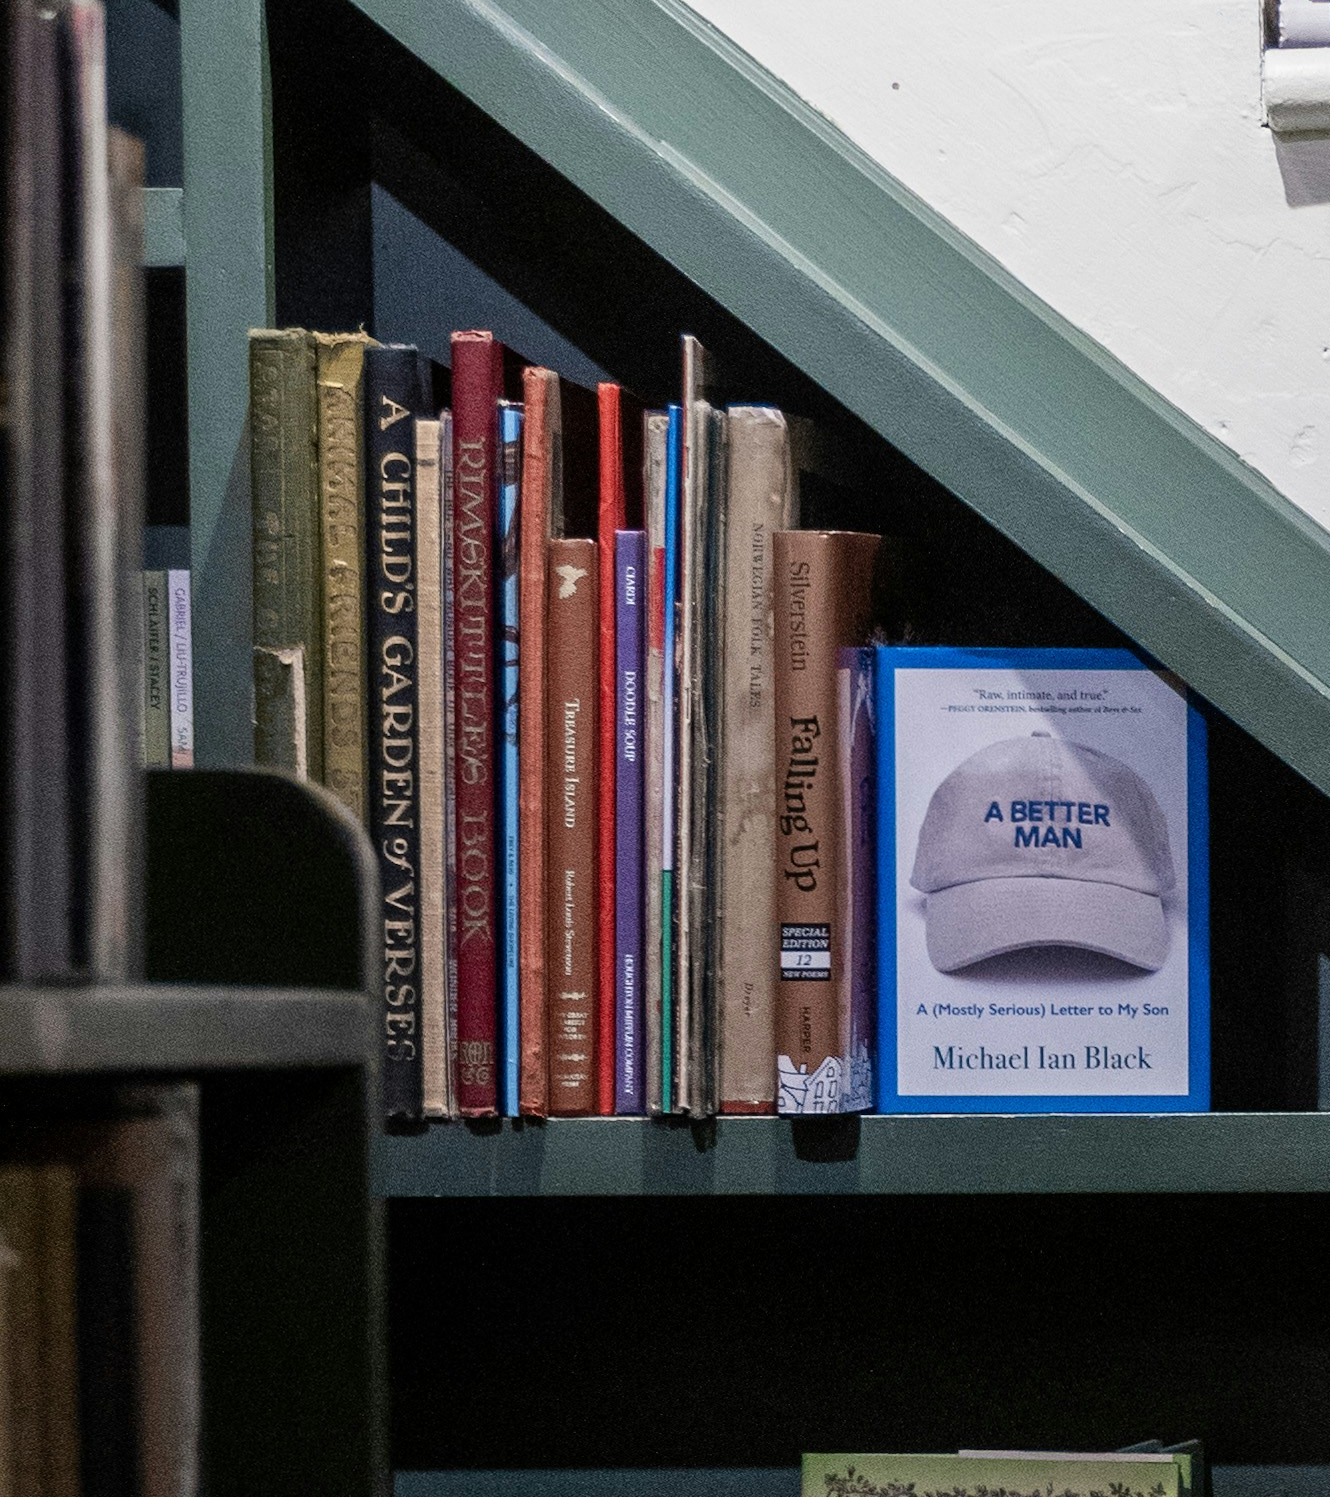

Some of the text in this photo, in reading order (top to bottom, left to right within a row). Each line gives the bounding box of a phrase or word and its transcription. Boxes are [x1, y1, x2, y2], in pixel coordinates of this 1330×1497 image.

[380, 396, 416, 1062] A CHILD'S GARDEN of VERSES
[780, 561, 821, 893] Silverstein Falling Up
[984, 801, 1110, 826] A BETTER
[1014, 827, 1082, 849] MAN
[461, 810, 492, 946] BOOK
[917, 1003, 1169, 1019] A (Mostly Serious) Letter to My Son
[933, 1046, 1152, 1070] Michael Ian Black
